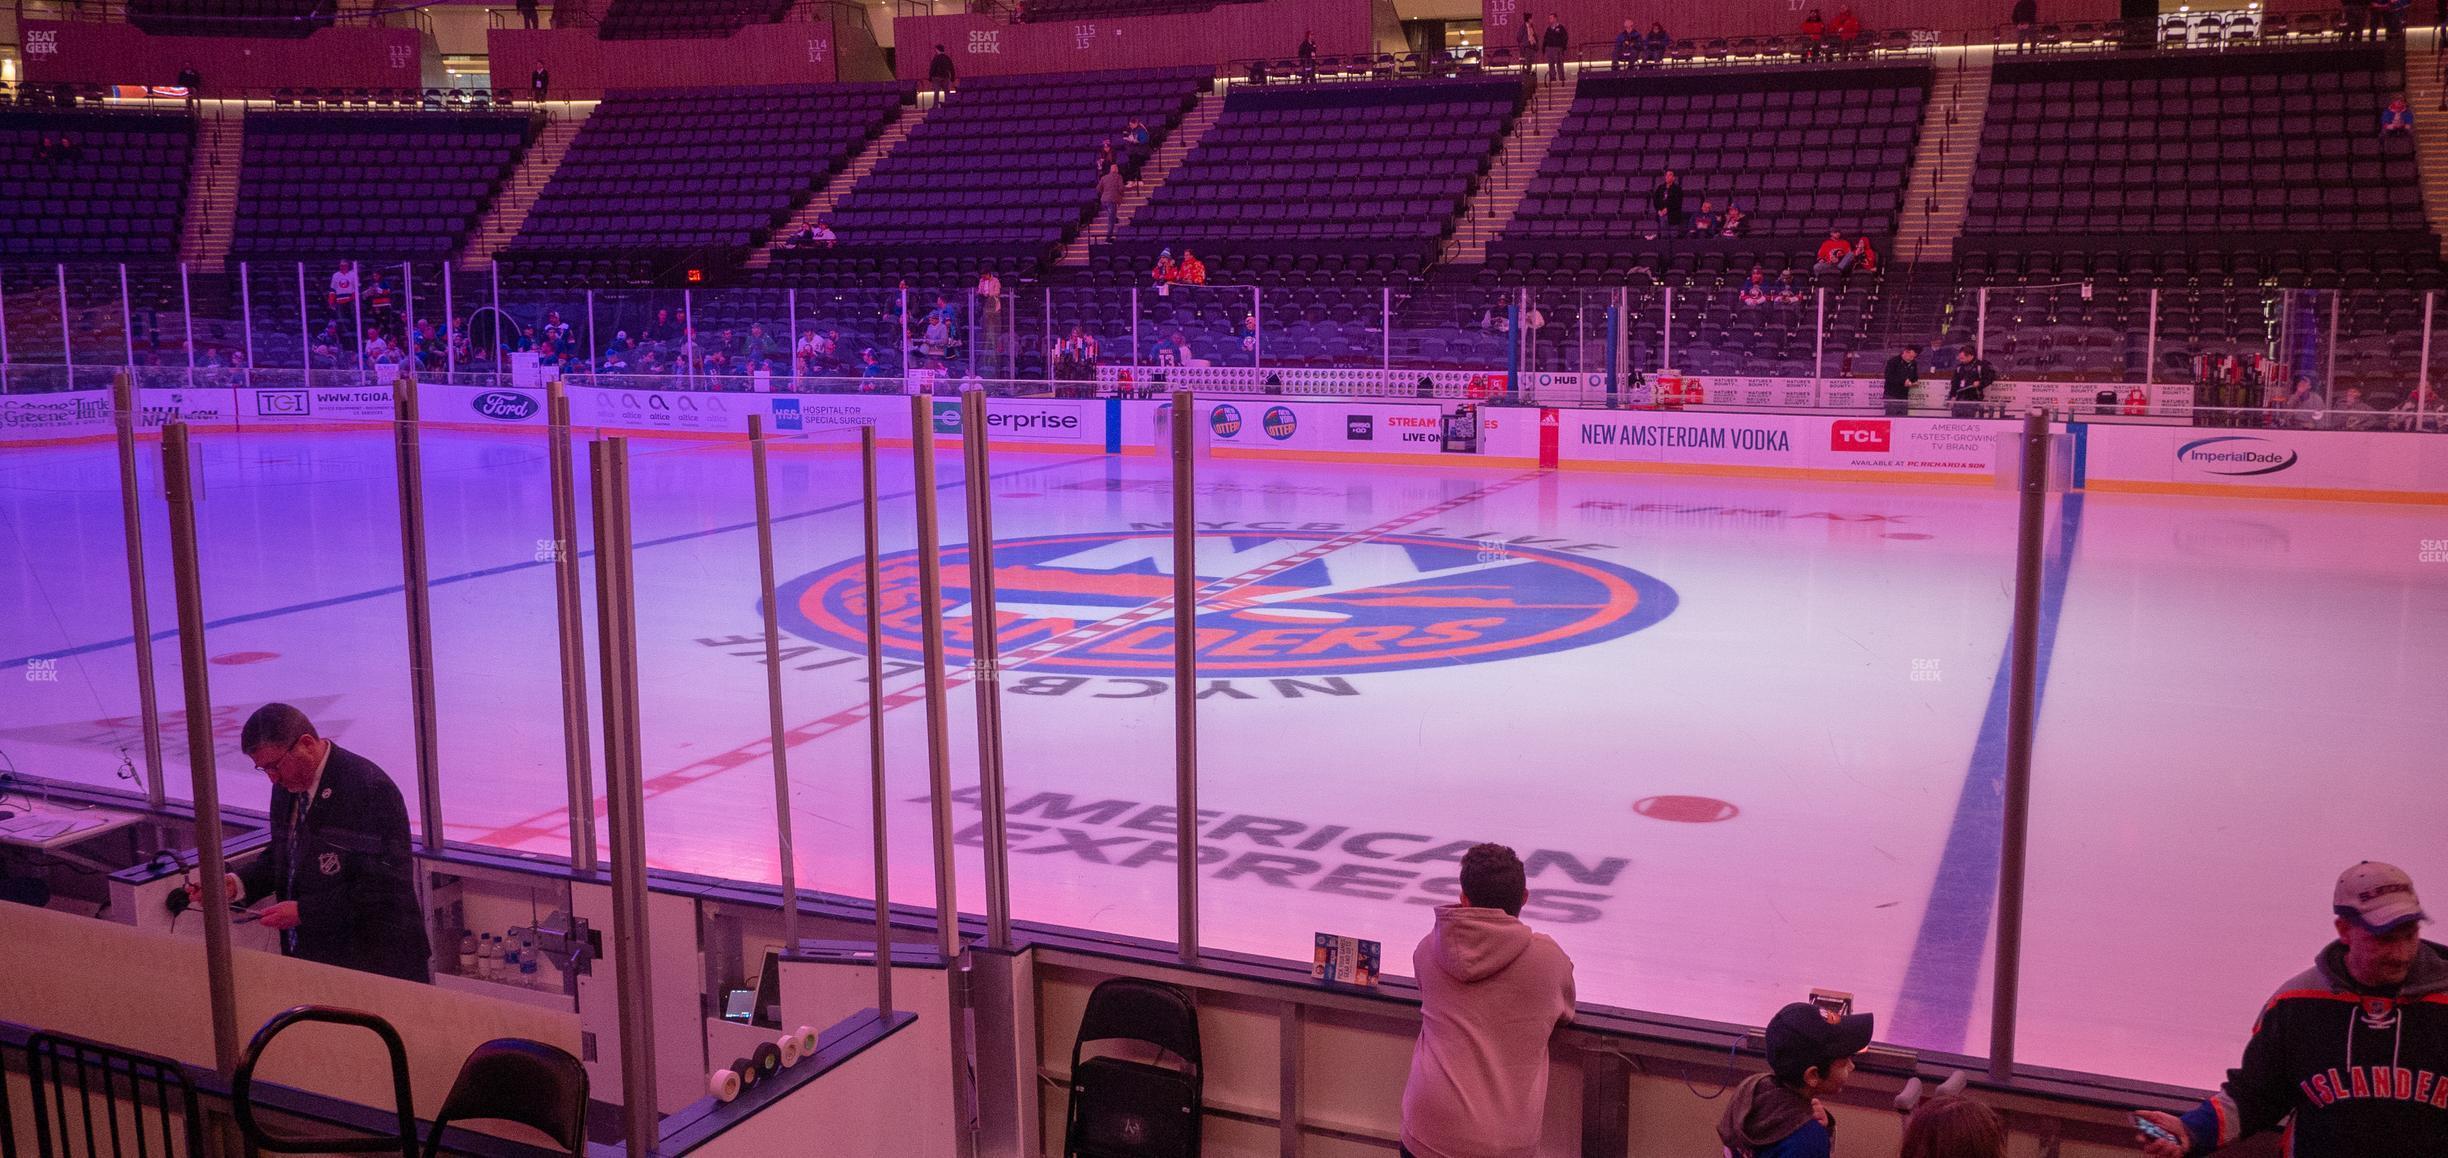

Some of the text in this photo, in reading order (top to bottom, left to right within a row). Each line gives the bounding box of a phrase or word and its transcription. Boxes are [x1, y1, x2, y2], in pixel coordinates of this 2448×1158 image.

[1075, 25, 1096, 36] 115
[808, 40, 827, 50] 114
[1076, 38, 1090, 49] 15
[808, 52, 821, 62] 14
[1554, 375, 1577, 384] HUB
[262, 394, 303, 411] TGI
[317, 393, 394, 402] WWW.TGIOA.
[482, 393, 529, 417] Ford
[803, 406, 844, 414] HOSPITAL
[649, 412, 671, 421] altice
[805, 416, 877, 425] SPECIAL SURGERY
[1388, 417, 1436, 428] STREAM
[1931, 424, 1981, 432] AMERICA'S
[1402, 433, 1426, 442] LIVE
[1581, 424, 1790, 452] NEW AMSTERDAM VODKA
[1840, 430, 1882, 442] TCL
[1931, 442, 1979, 452] TV BRAND
[1131, 521, 1345, 531] NYCB
